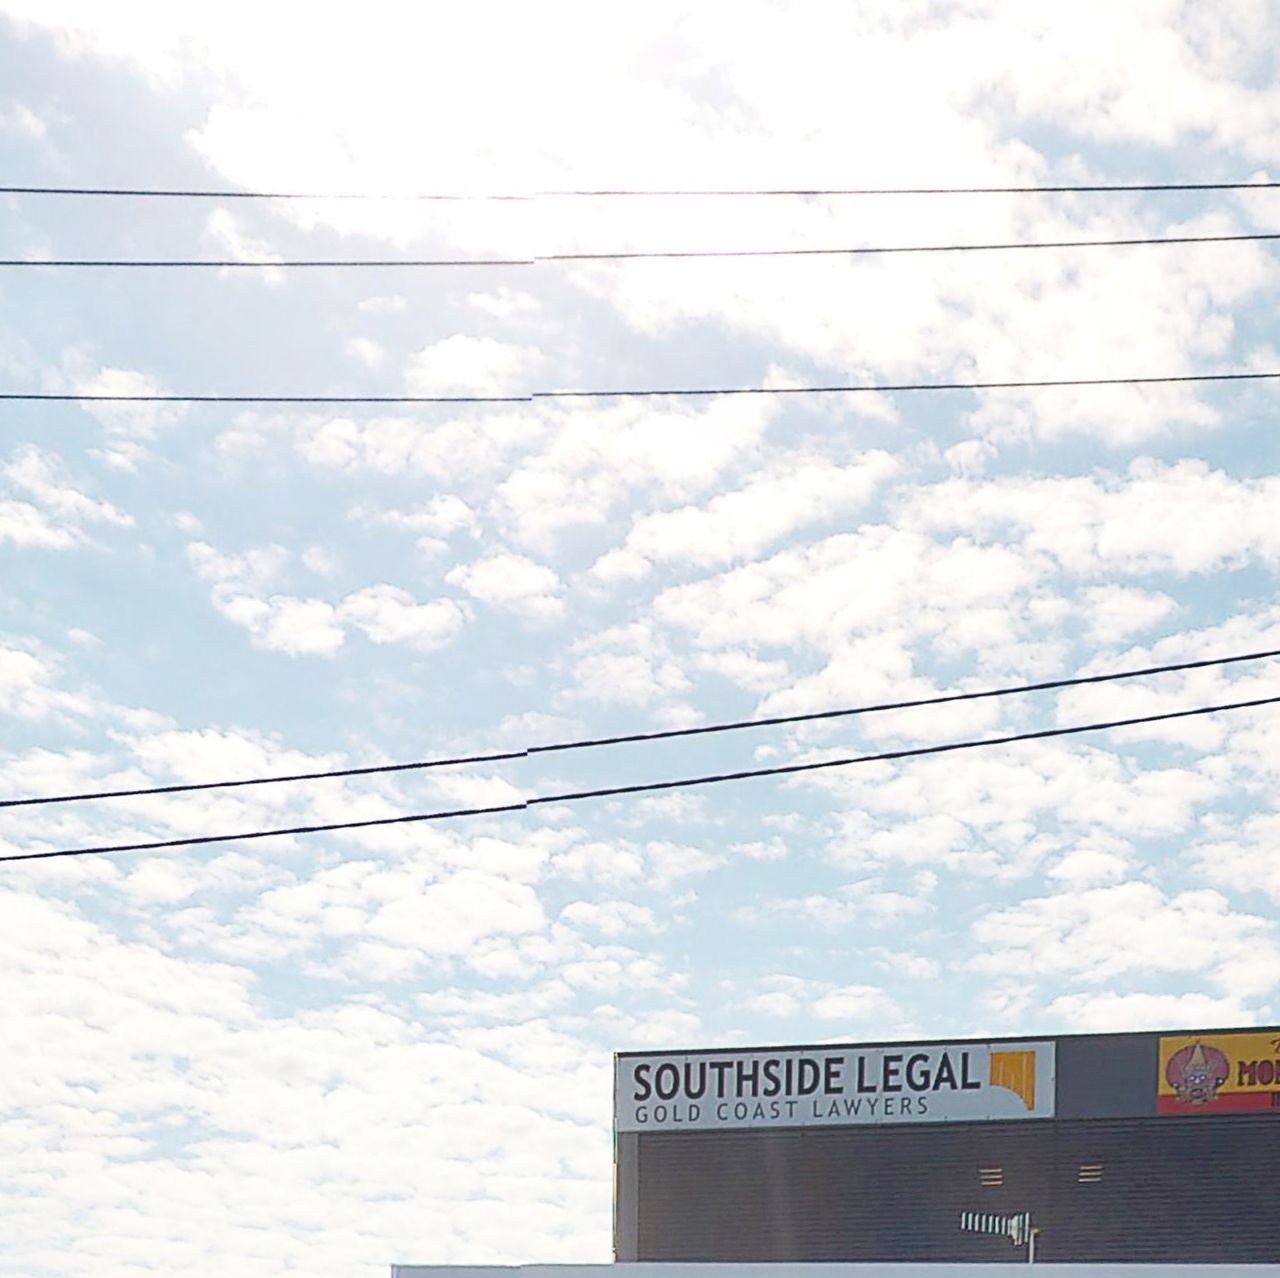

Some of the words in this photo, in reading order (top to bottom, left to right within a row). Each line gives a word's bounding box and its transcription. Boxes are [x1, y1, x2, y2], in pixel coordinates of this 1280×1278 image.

[633, 1056, 845, 1102] SOUTHSIDE
[857, 1051, 982, 1094] LEGAL
[635, 1103, 702, 1124] GOLD
[716, 1100, 799, 1121] COAST
[812, 1096, 929, 1118] LAWYERS
